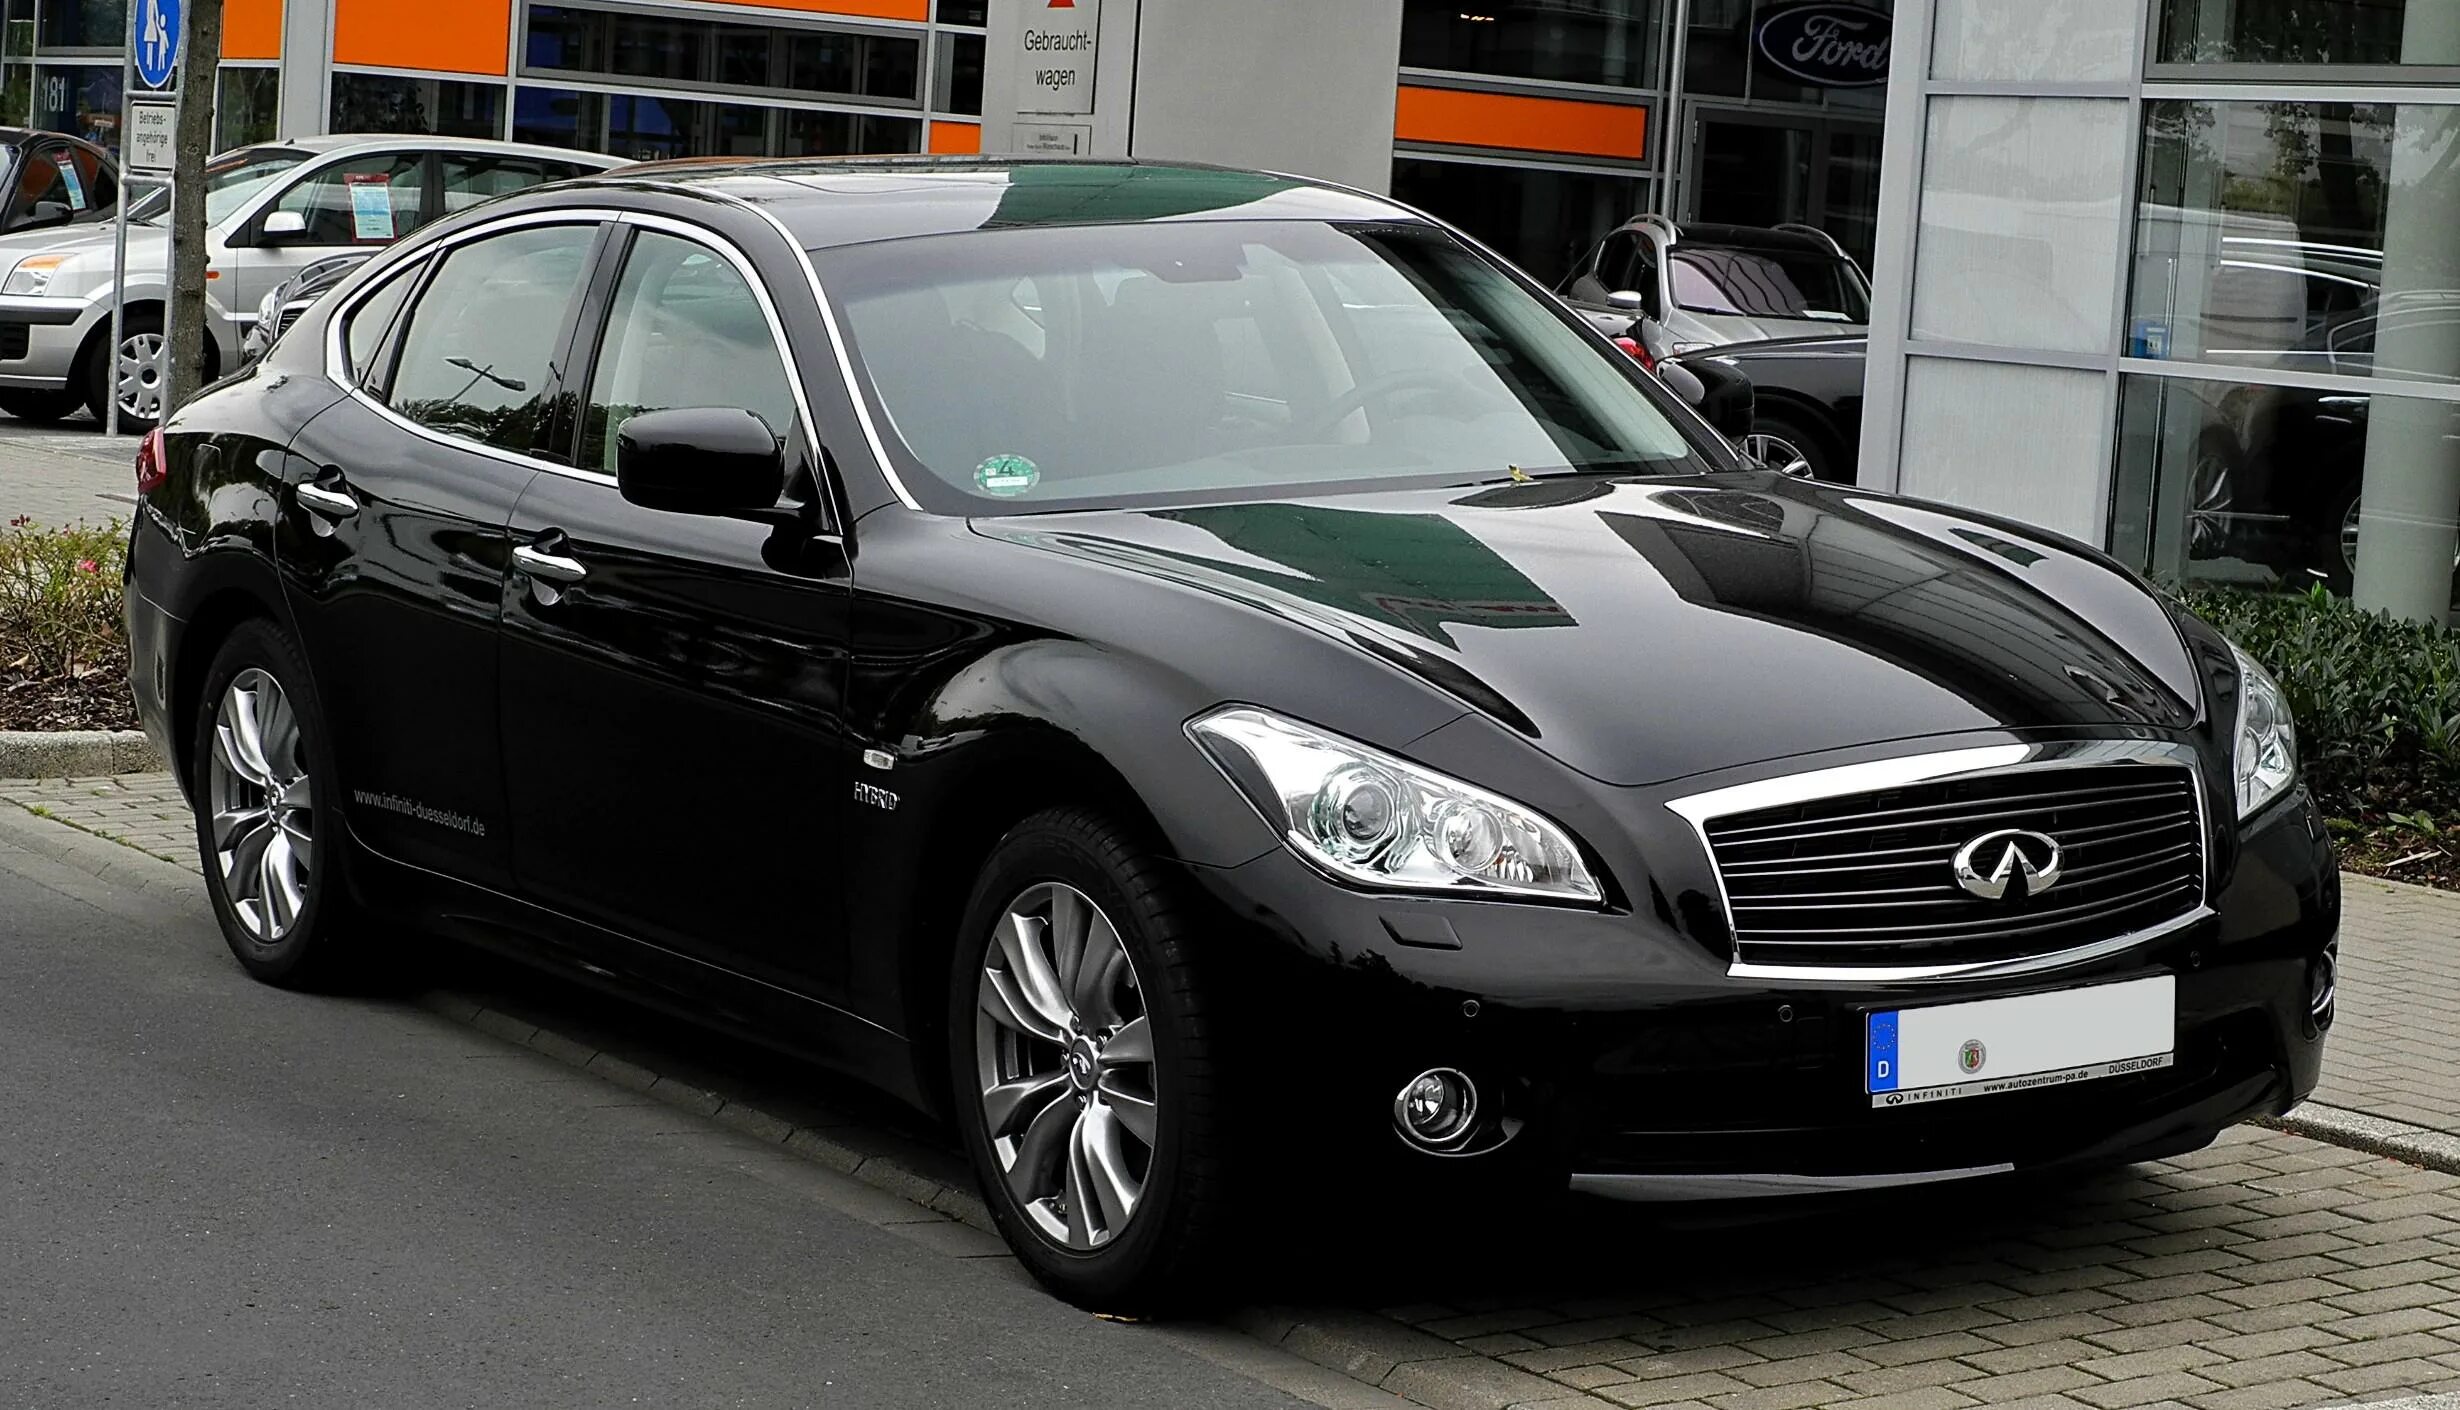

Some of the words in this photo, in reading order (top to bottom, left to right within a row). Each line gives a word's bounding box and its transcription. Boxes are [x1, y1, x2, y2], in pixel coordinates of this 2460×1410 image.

[1024, 29, 1092, 51] Gebraucht-
[1792, 15, 1890, 70] Ford
[1036, 69, 1076, 91] wagen
[43, 76, 65, 112] 181
[139, 110, 166, 125] Betriebs-
[999, 460, 1015, 476] 4
[354, 789, 486, 837] www.infiniti-duesseldorf.de
[1878, 1060, 1890, 1079] D
[1907, 1087, 1963, 1102] INFINITI
[1983, 1070, 2089, 1093] www.autozentrum-pa.de
